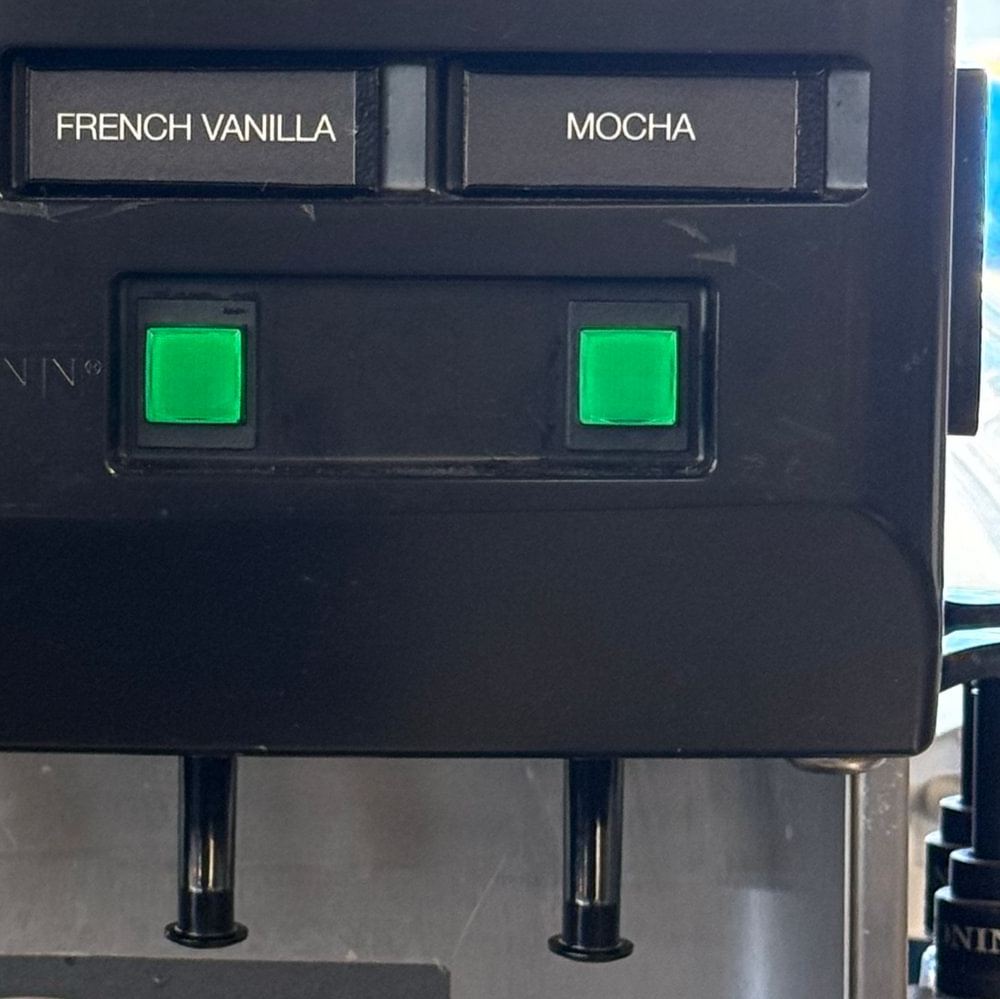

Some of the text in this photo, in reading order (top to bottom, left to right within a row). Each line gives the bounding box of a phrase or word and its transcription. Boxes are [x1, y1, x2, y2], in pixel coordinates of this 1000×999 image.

[56, 112, 338, 144] FRENCH VANILLA
[566, 111, 699, 143] MOCHA
